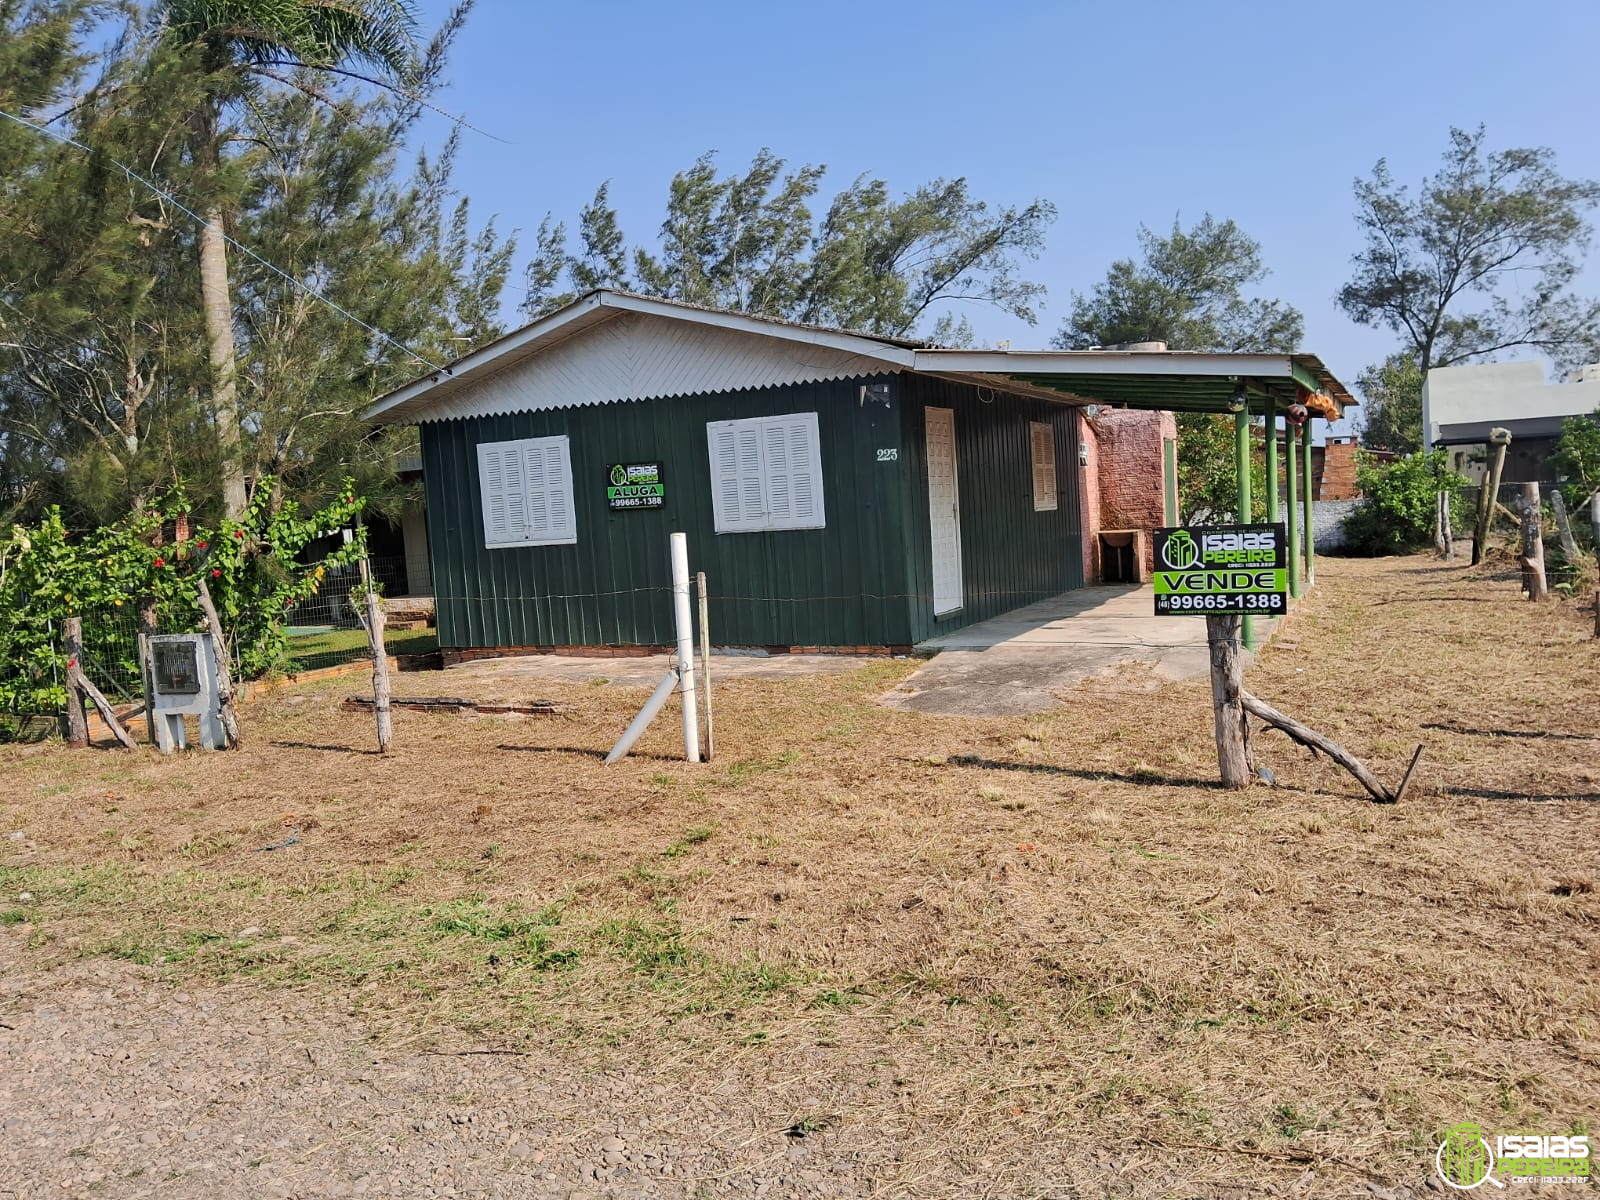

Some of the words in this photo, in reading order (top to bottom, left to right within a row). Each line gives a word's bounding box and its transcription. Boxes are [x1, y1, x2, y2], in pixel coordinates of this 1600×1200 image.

[876, 448, 898, 461] 223
[613, 486, 658, 497] ALUGA
[615, 497, 662, 507] 99665-1388
[1163, 572, 1275, 591] VENDE
[1170, 594, 1282, 609] 99665-1388
